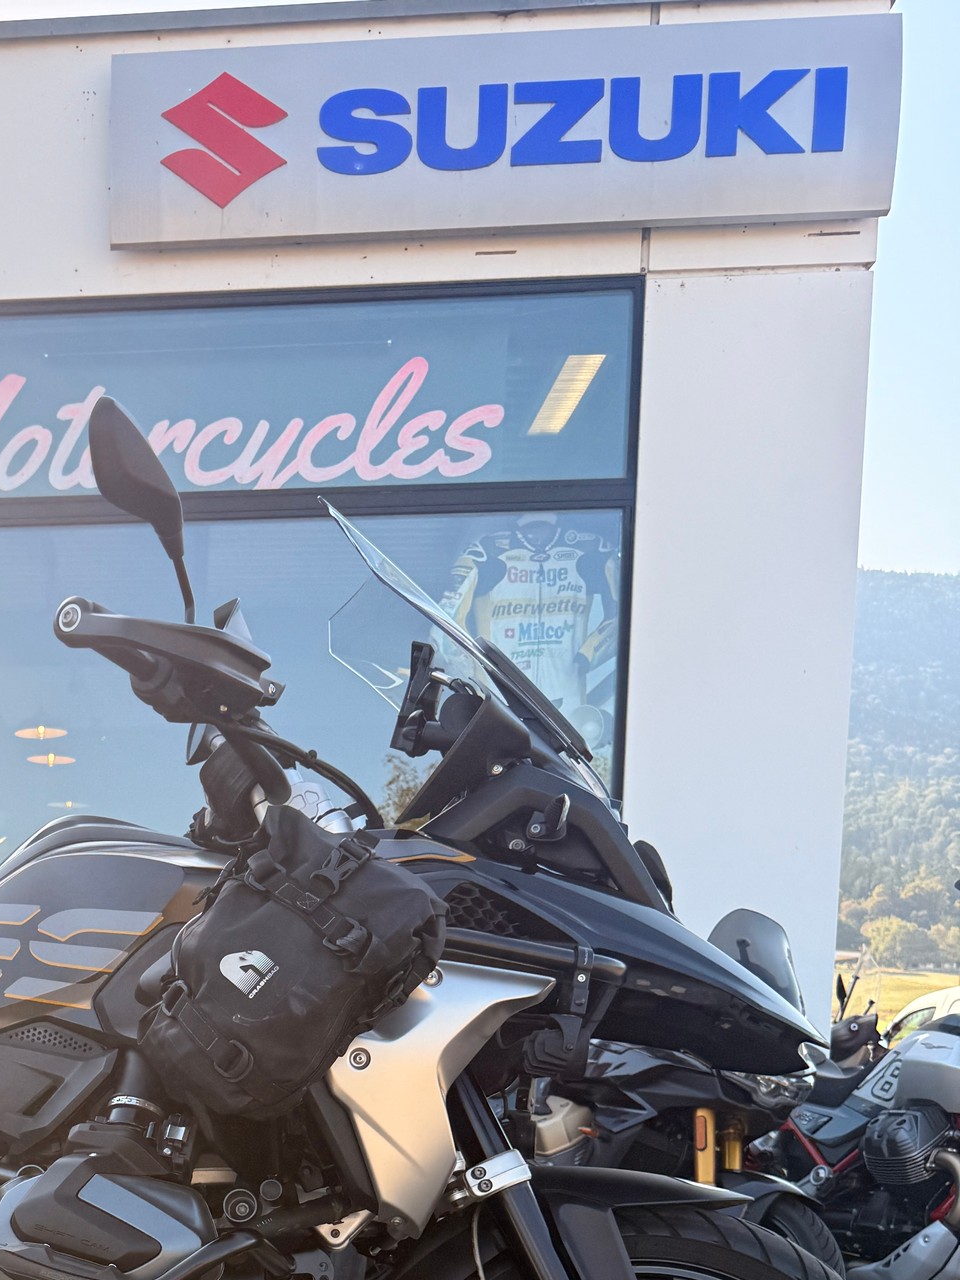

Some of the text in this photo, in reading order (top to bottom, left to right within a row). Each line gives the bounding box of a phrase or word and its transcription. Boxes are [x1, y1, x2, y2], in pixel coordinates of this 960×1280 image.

[317, 66, 848, 175] SUZUKI
[507, 566, 569, 587] Garage
[557, 581, 584, 595] plus
[518, 621, 566, 641] Milco
[248, 965, 280, 999] CRASHBAG
